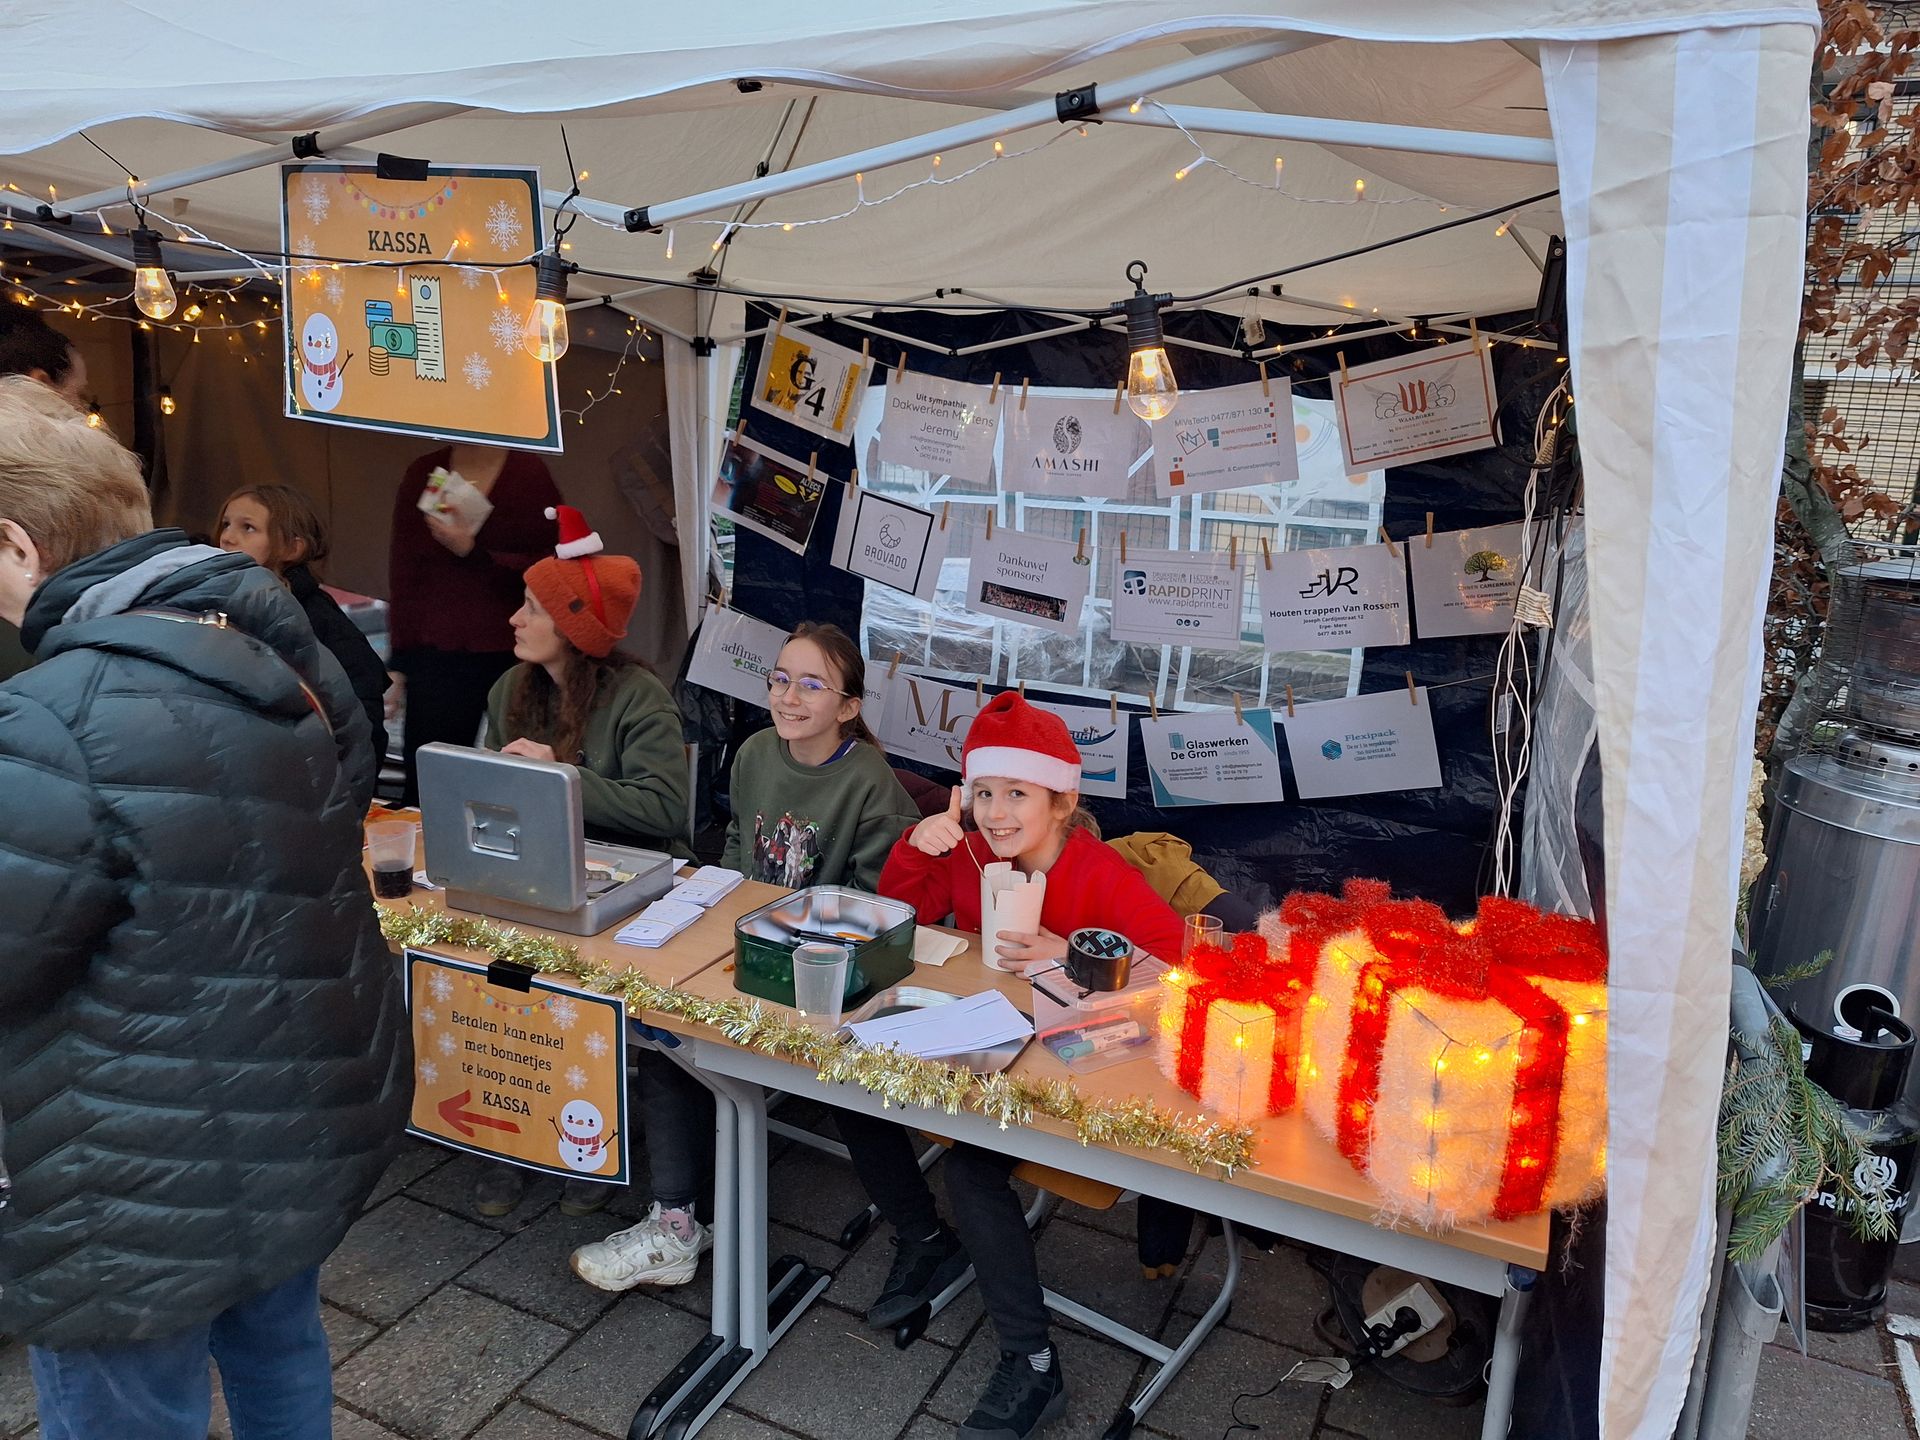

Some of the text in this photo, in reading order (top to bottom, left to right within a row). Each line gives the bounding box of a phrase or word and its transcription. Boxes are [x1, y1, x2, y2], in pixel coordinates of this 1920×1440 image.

[367, 229, 433, 256] KASSA
[804, 386, 826, 418] 4
[892, 397, 949, 419] Dakwerken
[916, 393, 967, 410] Uit sympathie
[1211, 409, 1245, 421] 0477/871
[1248, 407, 1262, 416] 130
[920, 421, 960, 440] Jeremy
[1031, 456, 1099, 472] AMASHI
[865, 545, 907, 569] BROVADO
[998, 552, 1048, 572] Dankuwel
[997, 566, 1044, 583] sponsors!
[1148, 584, 1232, 600] RAPIDPRINT
[1480, 581, 1516, 589] CAMERMANS
[1147, 598, 1229, 609] www.rapidprint.eu
[1269, 601, 1400, 618] Houten trappen Van Rossem
[721, 642, 763, 664] adfinas
[1186, 737, 1249, 750] Glaswerken
[1344, 729, 1396, 742] Flexipack
[1171, 751, 1185, 760] De
[1187, 750, 1218, 759] Grom
[451, 1010, 564, 1051] Betalen kan enkel
[464, 1038, 552, 1071] met bonnetjes
[461, 1061, 551, 1095] te koop aan de
[482, 1090, 531, 1117] KASSA
